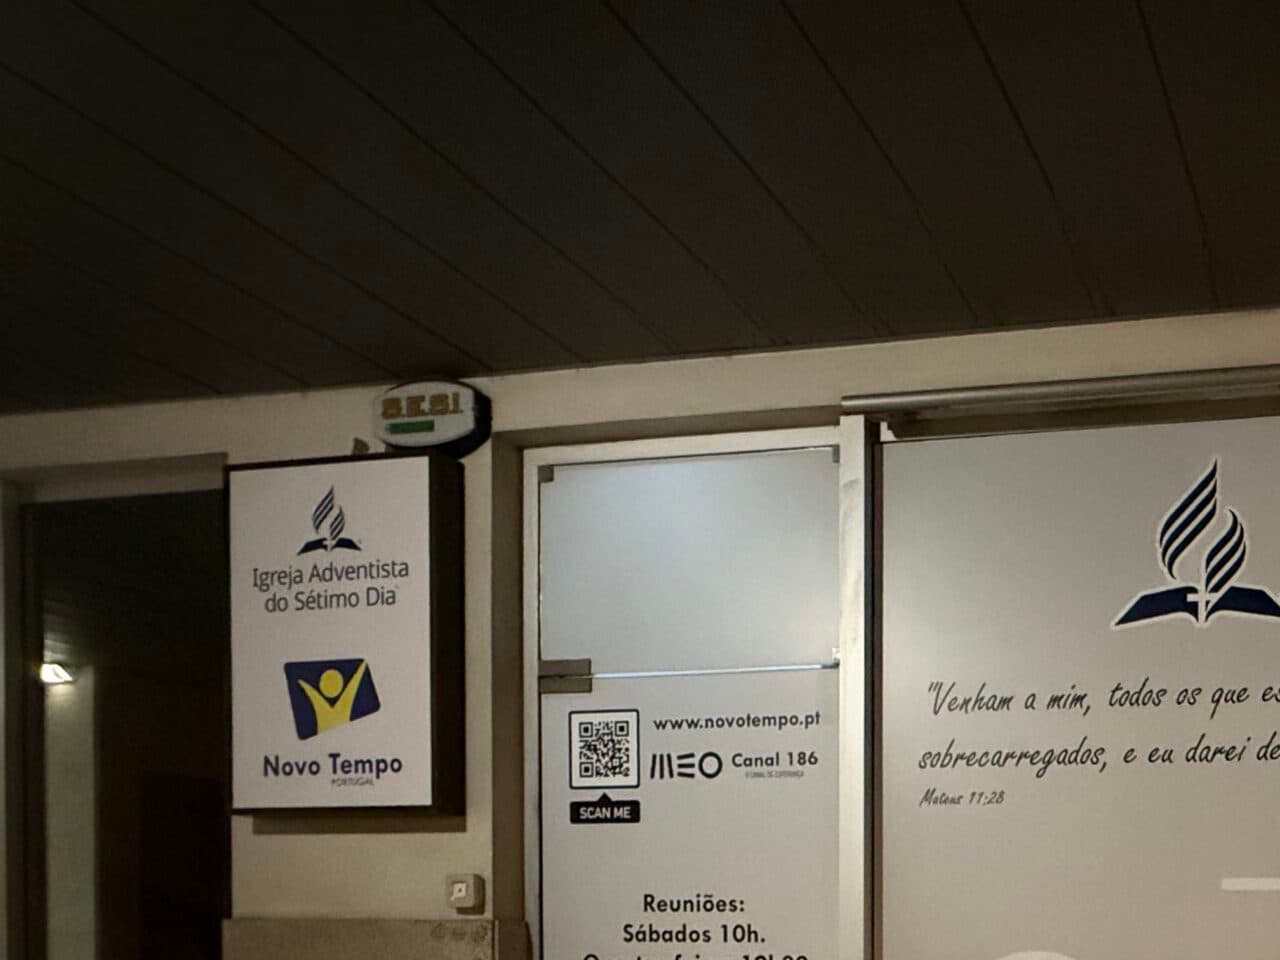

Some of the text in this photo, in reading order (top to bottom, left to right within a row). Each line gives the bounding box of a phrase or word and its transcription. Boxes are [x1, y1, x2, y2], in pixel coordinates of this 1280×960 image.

[252, 559, 409, 593] Igreja Adventista
[264, 585, 396, 614] do Sétimo Dia
[1024, 692, 1037, 711] a
[1046, 687, 1092, 717] mim,
[1108, 676, 1166, 708] todos
[1175, 687, 1203, 706] os
[1210, 687, 1250, 720] que
[652, 711, 821, 731] www.novotempo.pt
[263, 752, 403, 780] Novo Tempo
[731, 751, 819, 768] Canal 186
[918, 735, 1108, 779] sobrecarregados,
[1122, 747, 1138, 764] e
[1147, 747, 1174, 764] eu
[1185, 732, 1247, 764] darei
[579, 806, 631, 820] SCAN ME
[643, 893, 745, 913] Reuniões:
[623, 923, 766, 943] Sábados 10h.
